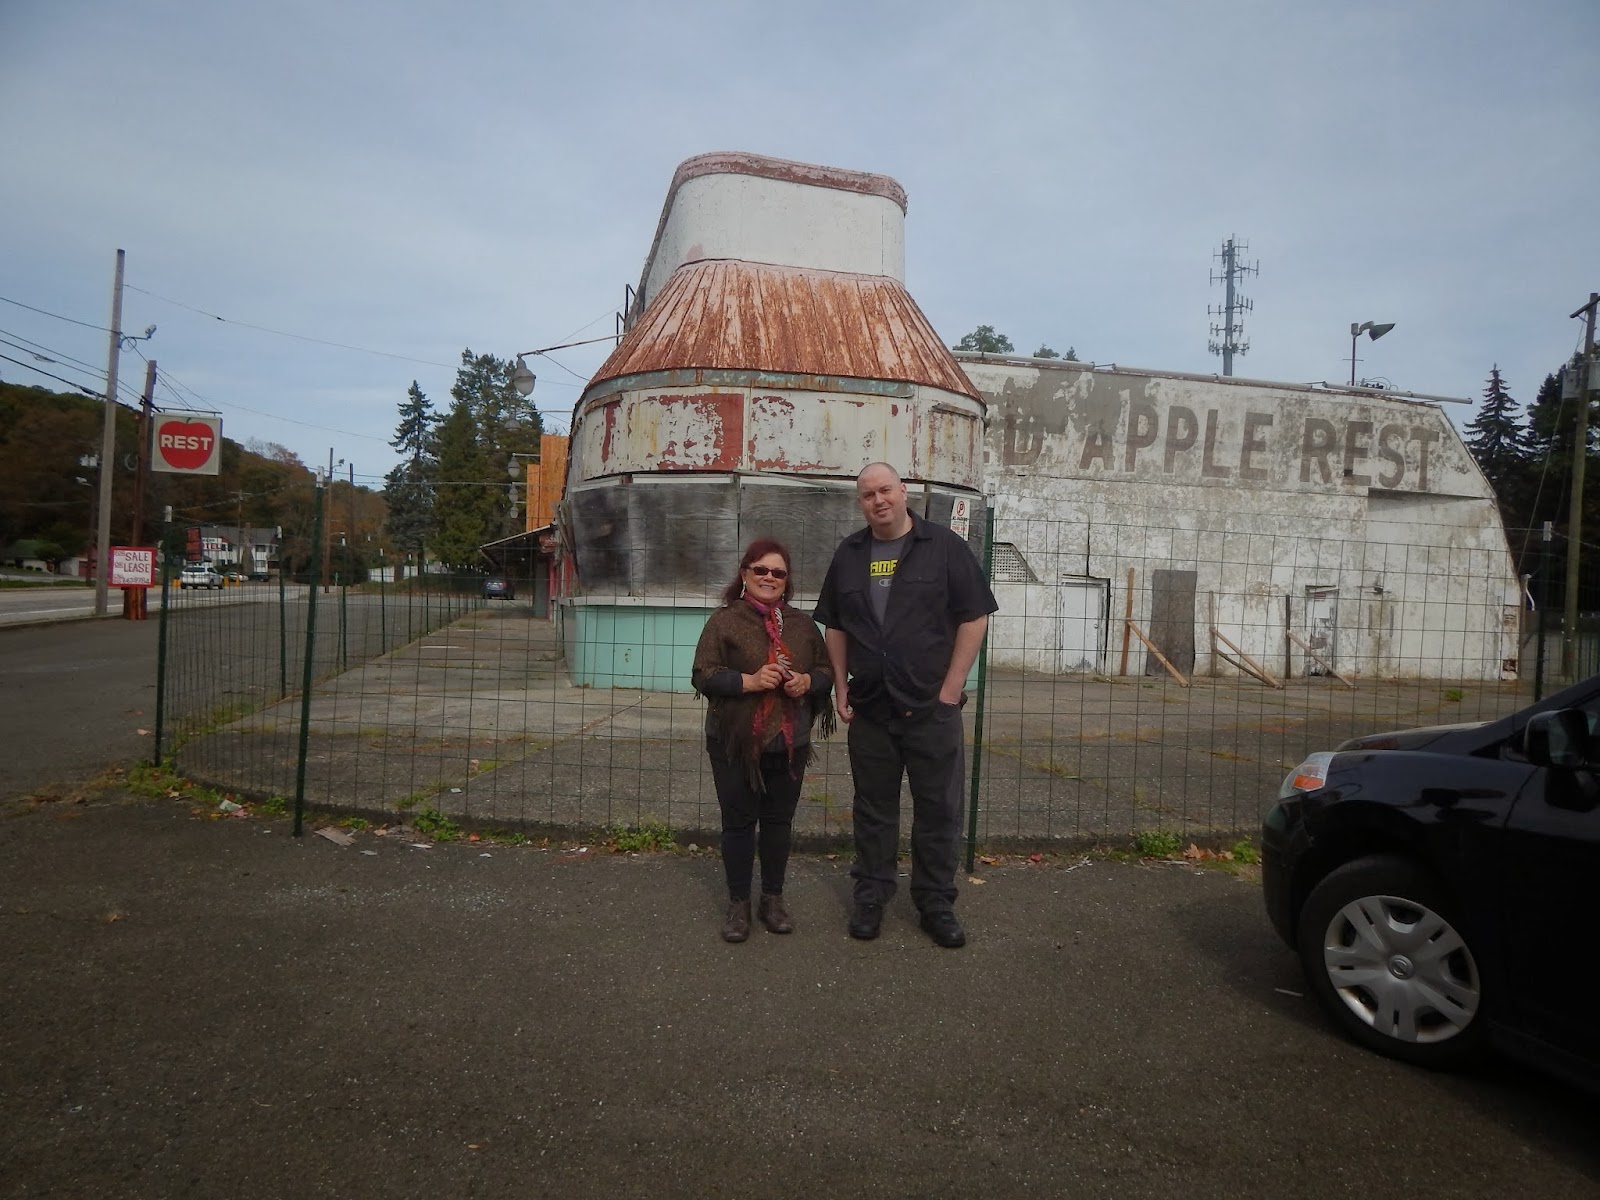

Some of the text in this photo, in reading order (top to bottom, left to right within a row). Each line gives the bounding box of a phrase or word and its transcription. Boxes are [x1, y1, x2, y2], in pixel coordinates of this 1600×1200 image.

[161, 434, 212, 451] REST
[1078, 404, 1274, 481] APPLE
[1300, 417, 1440, 491] REST
[125, 552, 149, 562] SALE
[123, 563, 150, 573] LEASE
